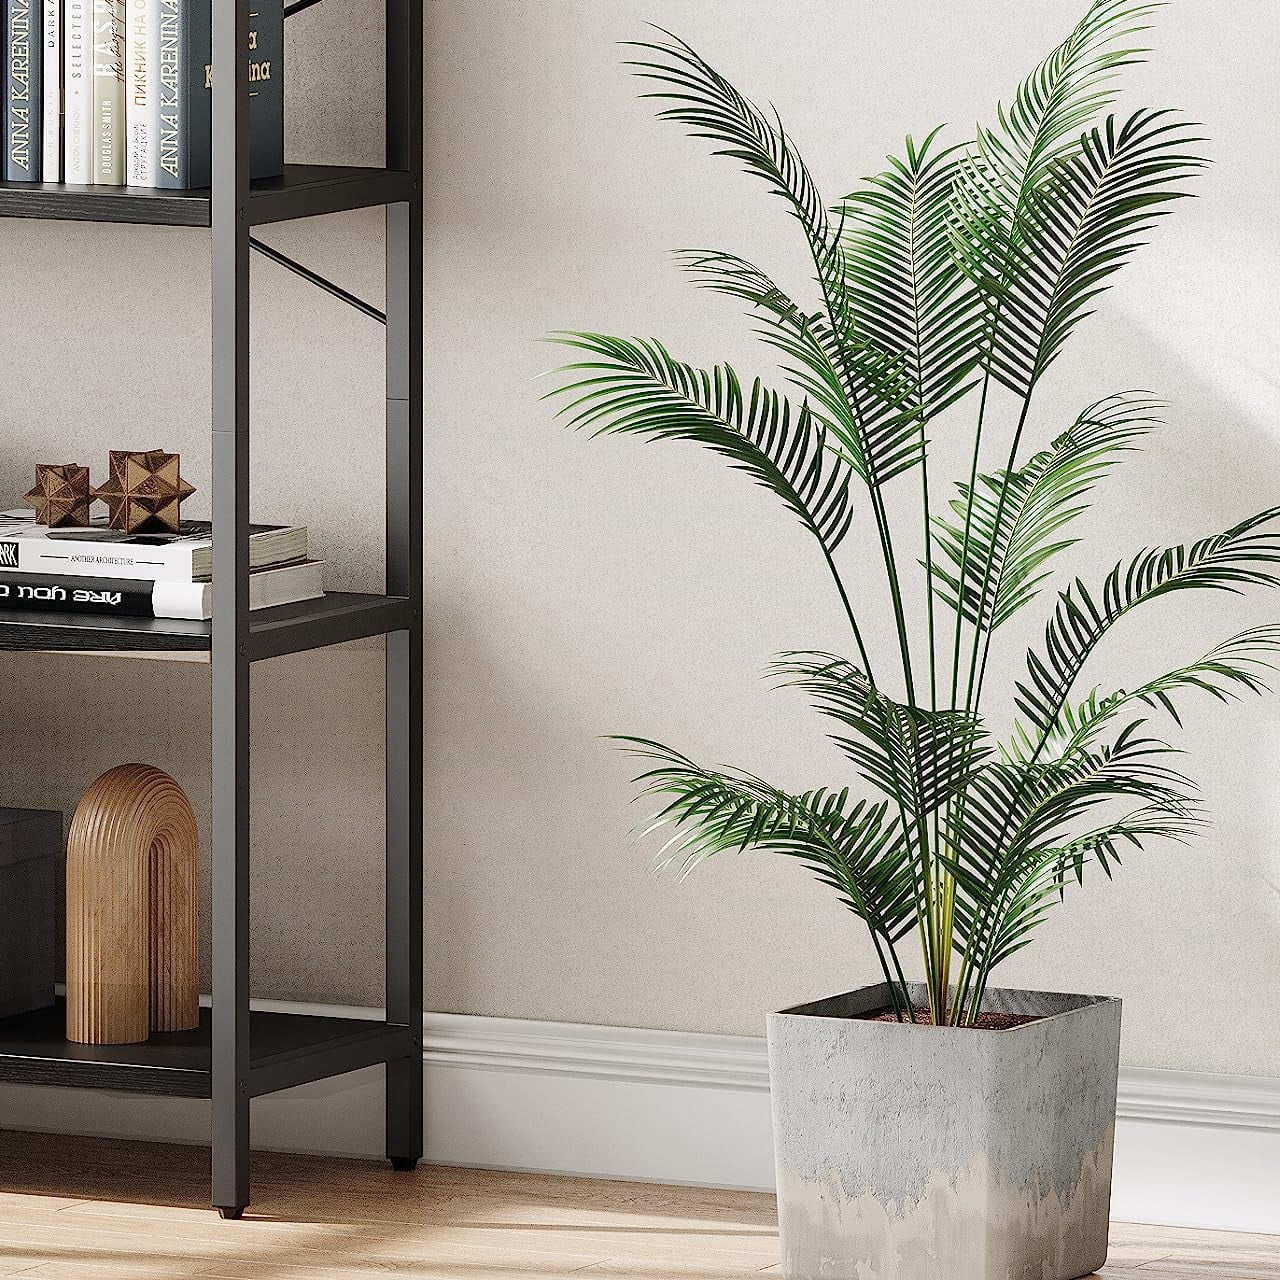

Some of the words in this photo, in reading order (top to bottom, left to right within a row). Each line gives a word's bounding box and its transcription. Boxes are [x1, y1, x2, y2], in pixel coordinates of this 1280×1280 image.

[47, 9, 55, 48] DARK
[71, 3, 82, 79] SELECTED
[134, 14, 146, 36] НА
[109, 60, 124, 83] the
[134, 41, 146, 106] ПИКНИК
[102, 100, 112, 129] SMITH
[11, 106, 29, 171] ANNA
[102, 131, 112, 174] DOUGLAS
[160, 113, 178, 178] ANNA
[70, 555, 95, 563] ANOTHER
[96, 556, 134, 566] ARCHITECTURE
